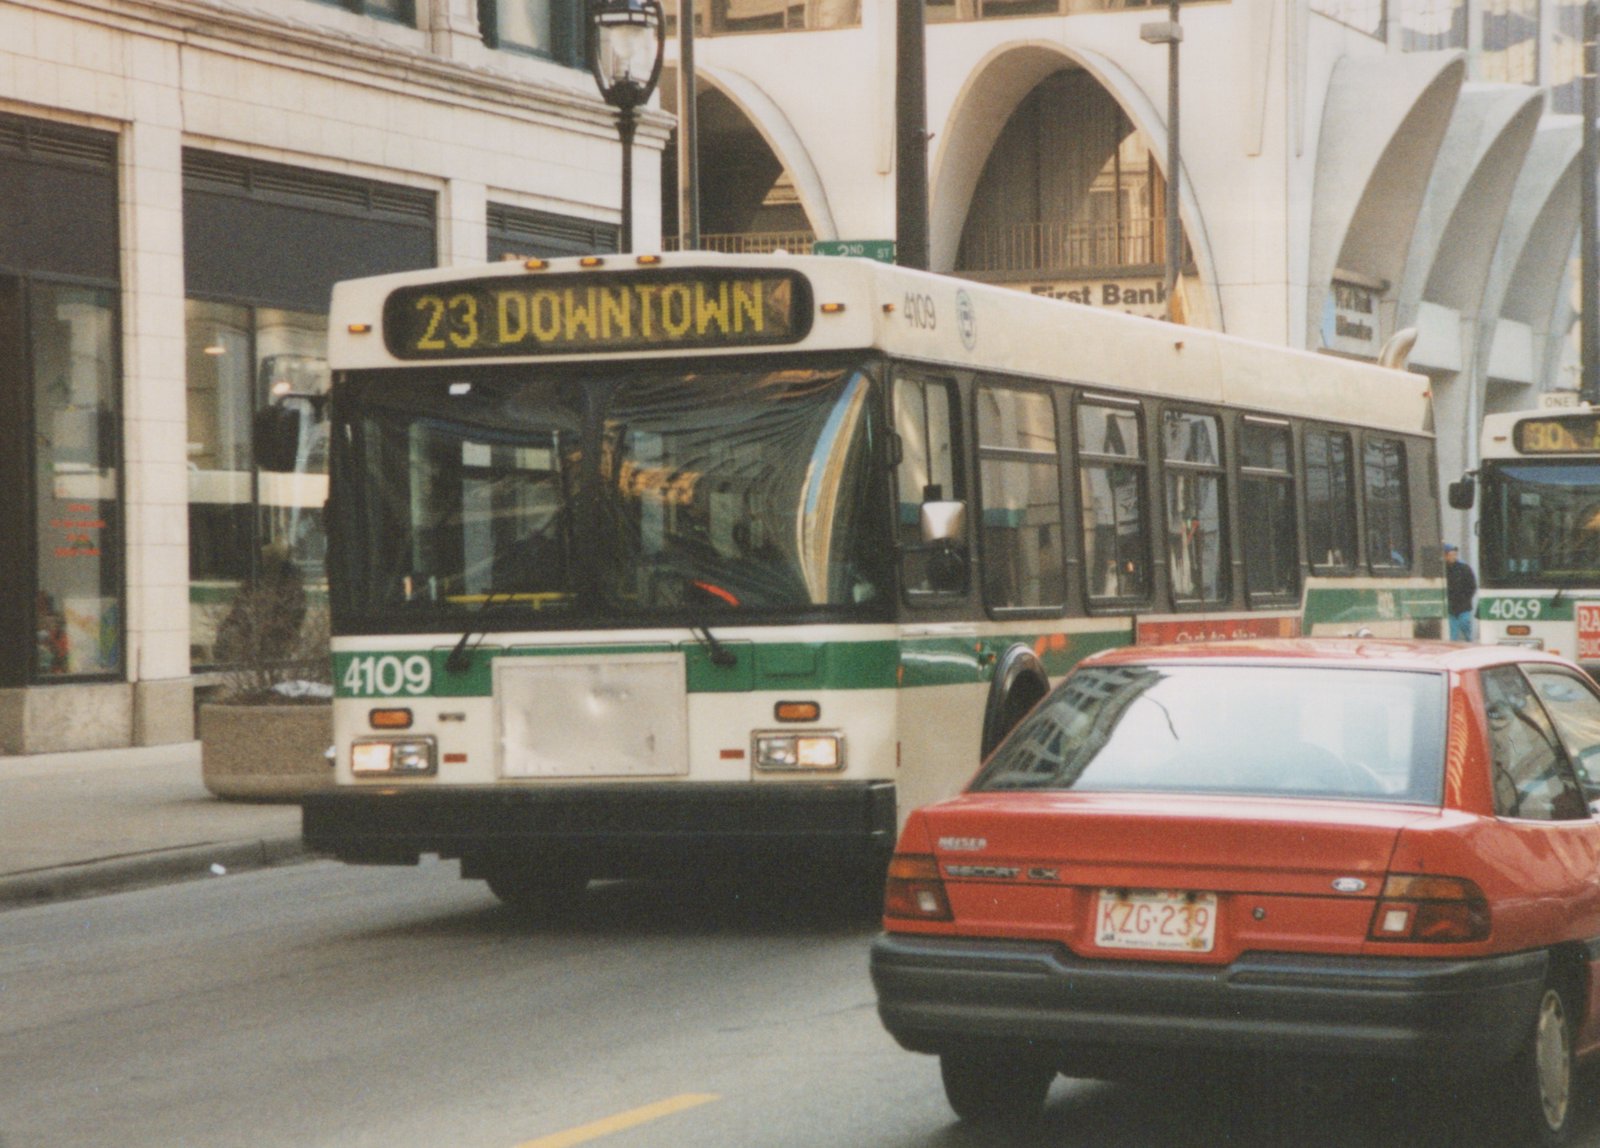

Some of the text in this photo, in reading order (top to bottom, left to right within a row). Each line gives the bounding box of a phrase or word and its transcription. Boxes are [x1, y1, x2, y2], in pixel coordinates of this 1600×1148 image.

[837, 244, 865, 257] 2ND
[877, 248, 890, 259] ST
[1102, 282, 1167, 306] Bank
[416, 279, 764, 350] 23 DOWNTOWN
[903, 292, 937, 330] 4109
[1489, 599, 1541, 619] 4069
[343, 655, 432, 695] 4109
